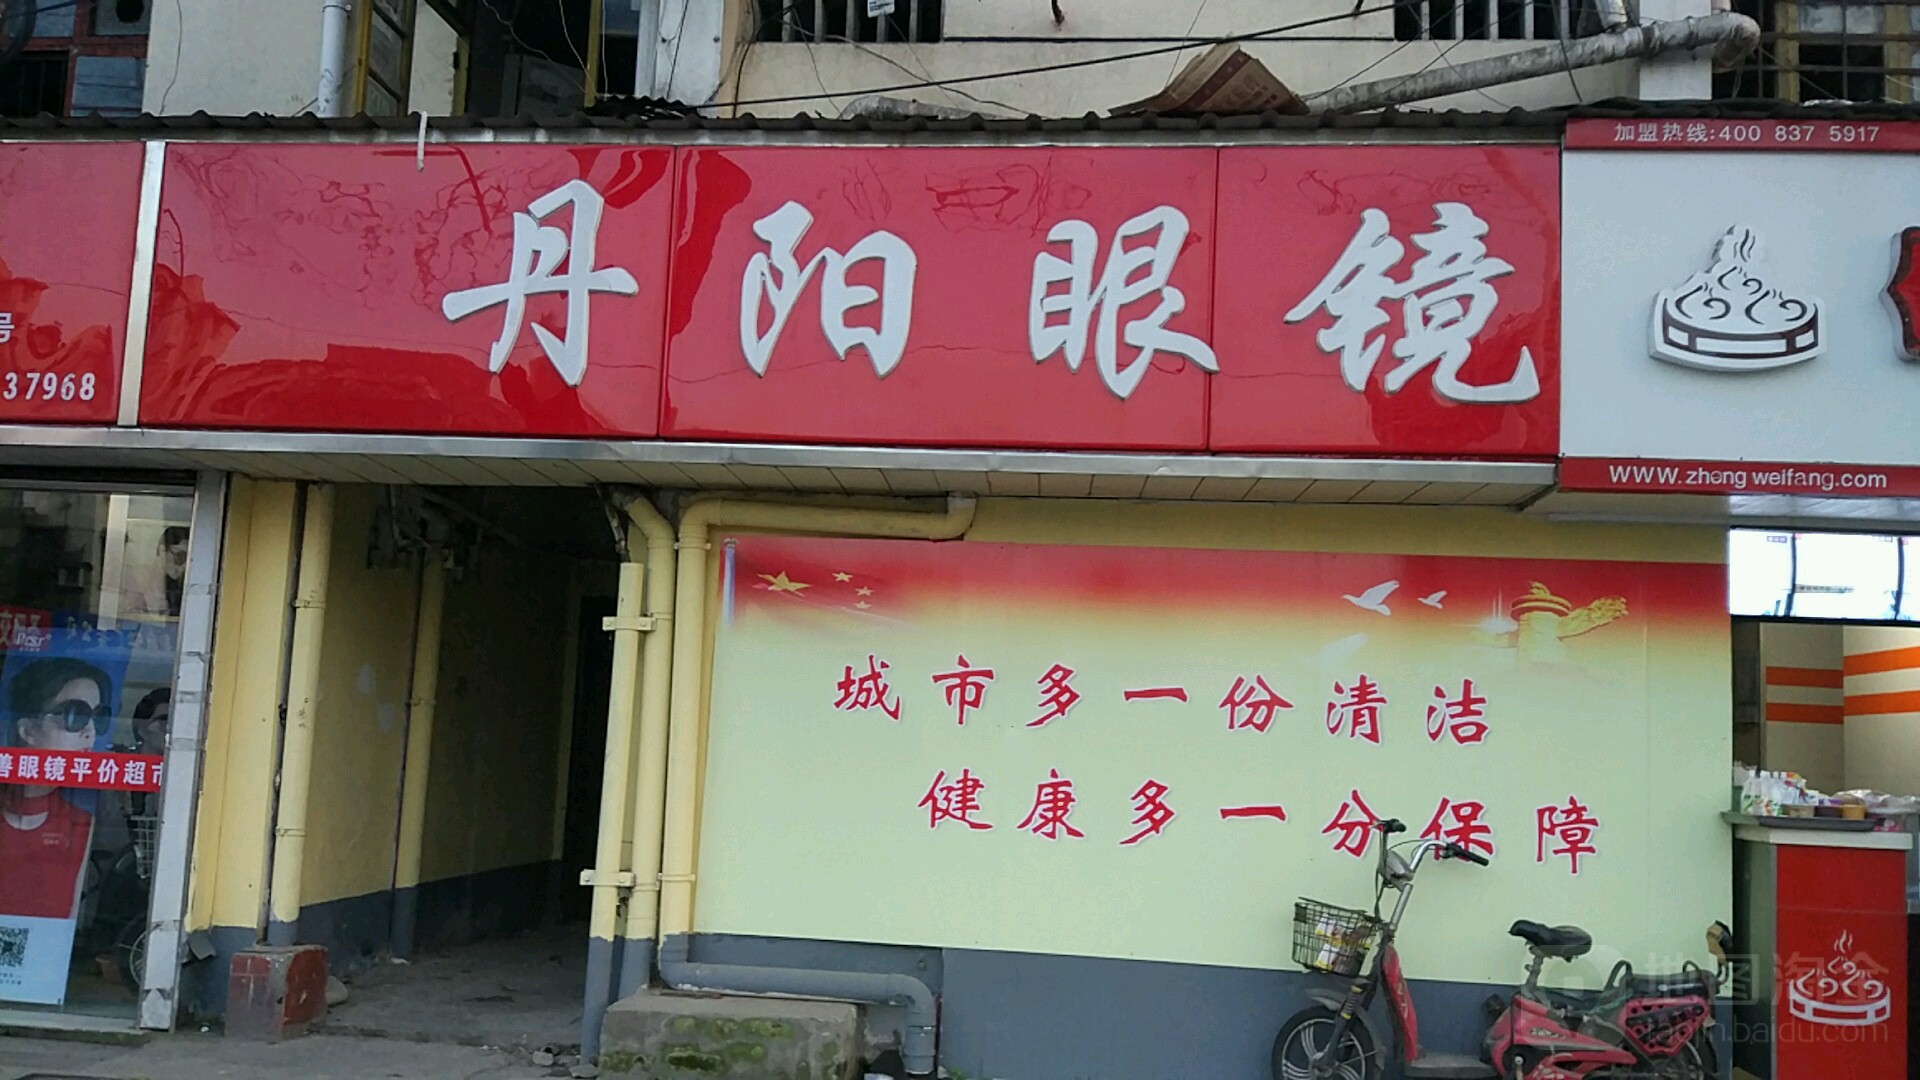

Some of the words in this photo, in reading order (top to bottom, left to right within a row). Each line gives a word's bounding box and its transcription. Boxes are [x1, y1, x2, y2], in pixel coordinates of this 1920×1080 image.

[1774, 125, 1815, 142] 837
[1828, 126, 1881, 143] 5917
[441, 178, 1541, 406] 丹阳眼镜
[2, 371, 96, 401] 37968
[834, 655, 1492, 745] 城市多一份清洁
[917, 768, 1600, 874] 健康多一分保障
